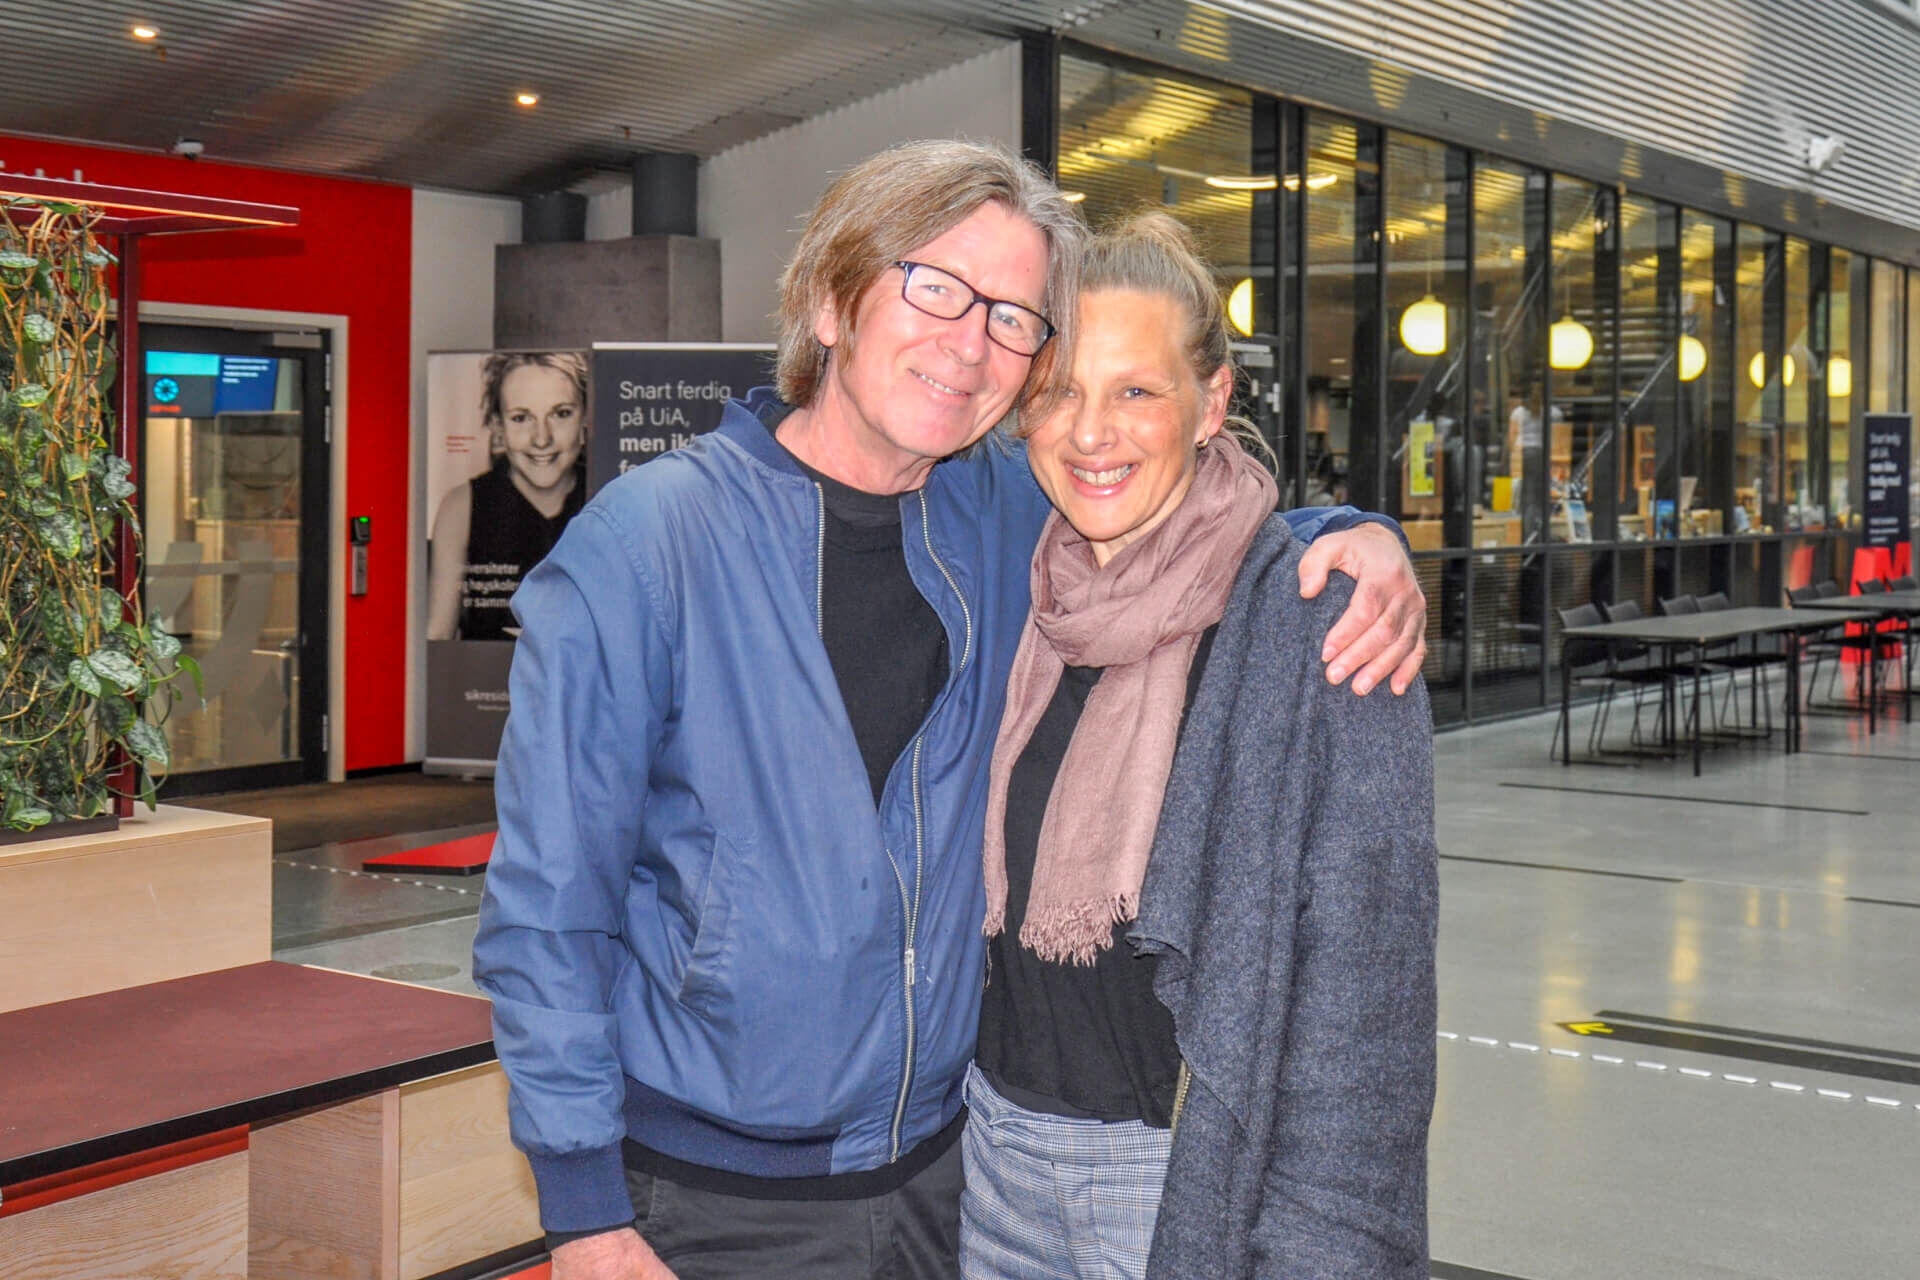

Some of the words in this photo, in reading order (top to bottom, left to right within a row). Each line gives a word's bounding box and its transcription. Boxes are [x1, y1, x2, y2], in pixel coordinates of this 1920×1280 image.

[619, 380, 672, 400] Snart
[677, 380, 731, 404] ferdig
[620, 406, 644, 430] på
[650, 407, 690, 428] UiA,
[619, 437, 666, 452] men
